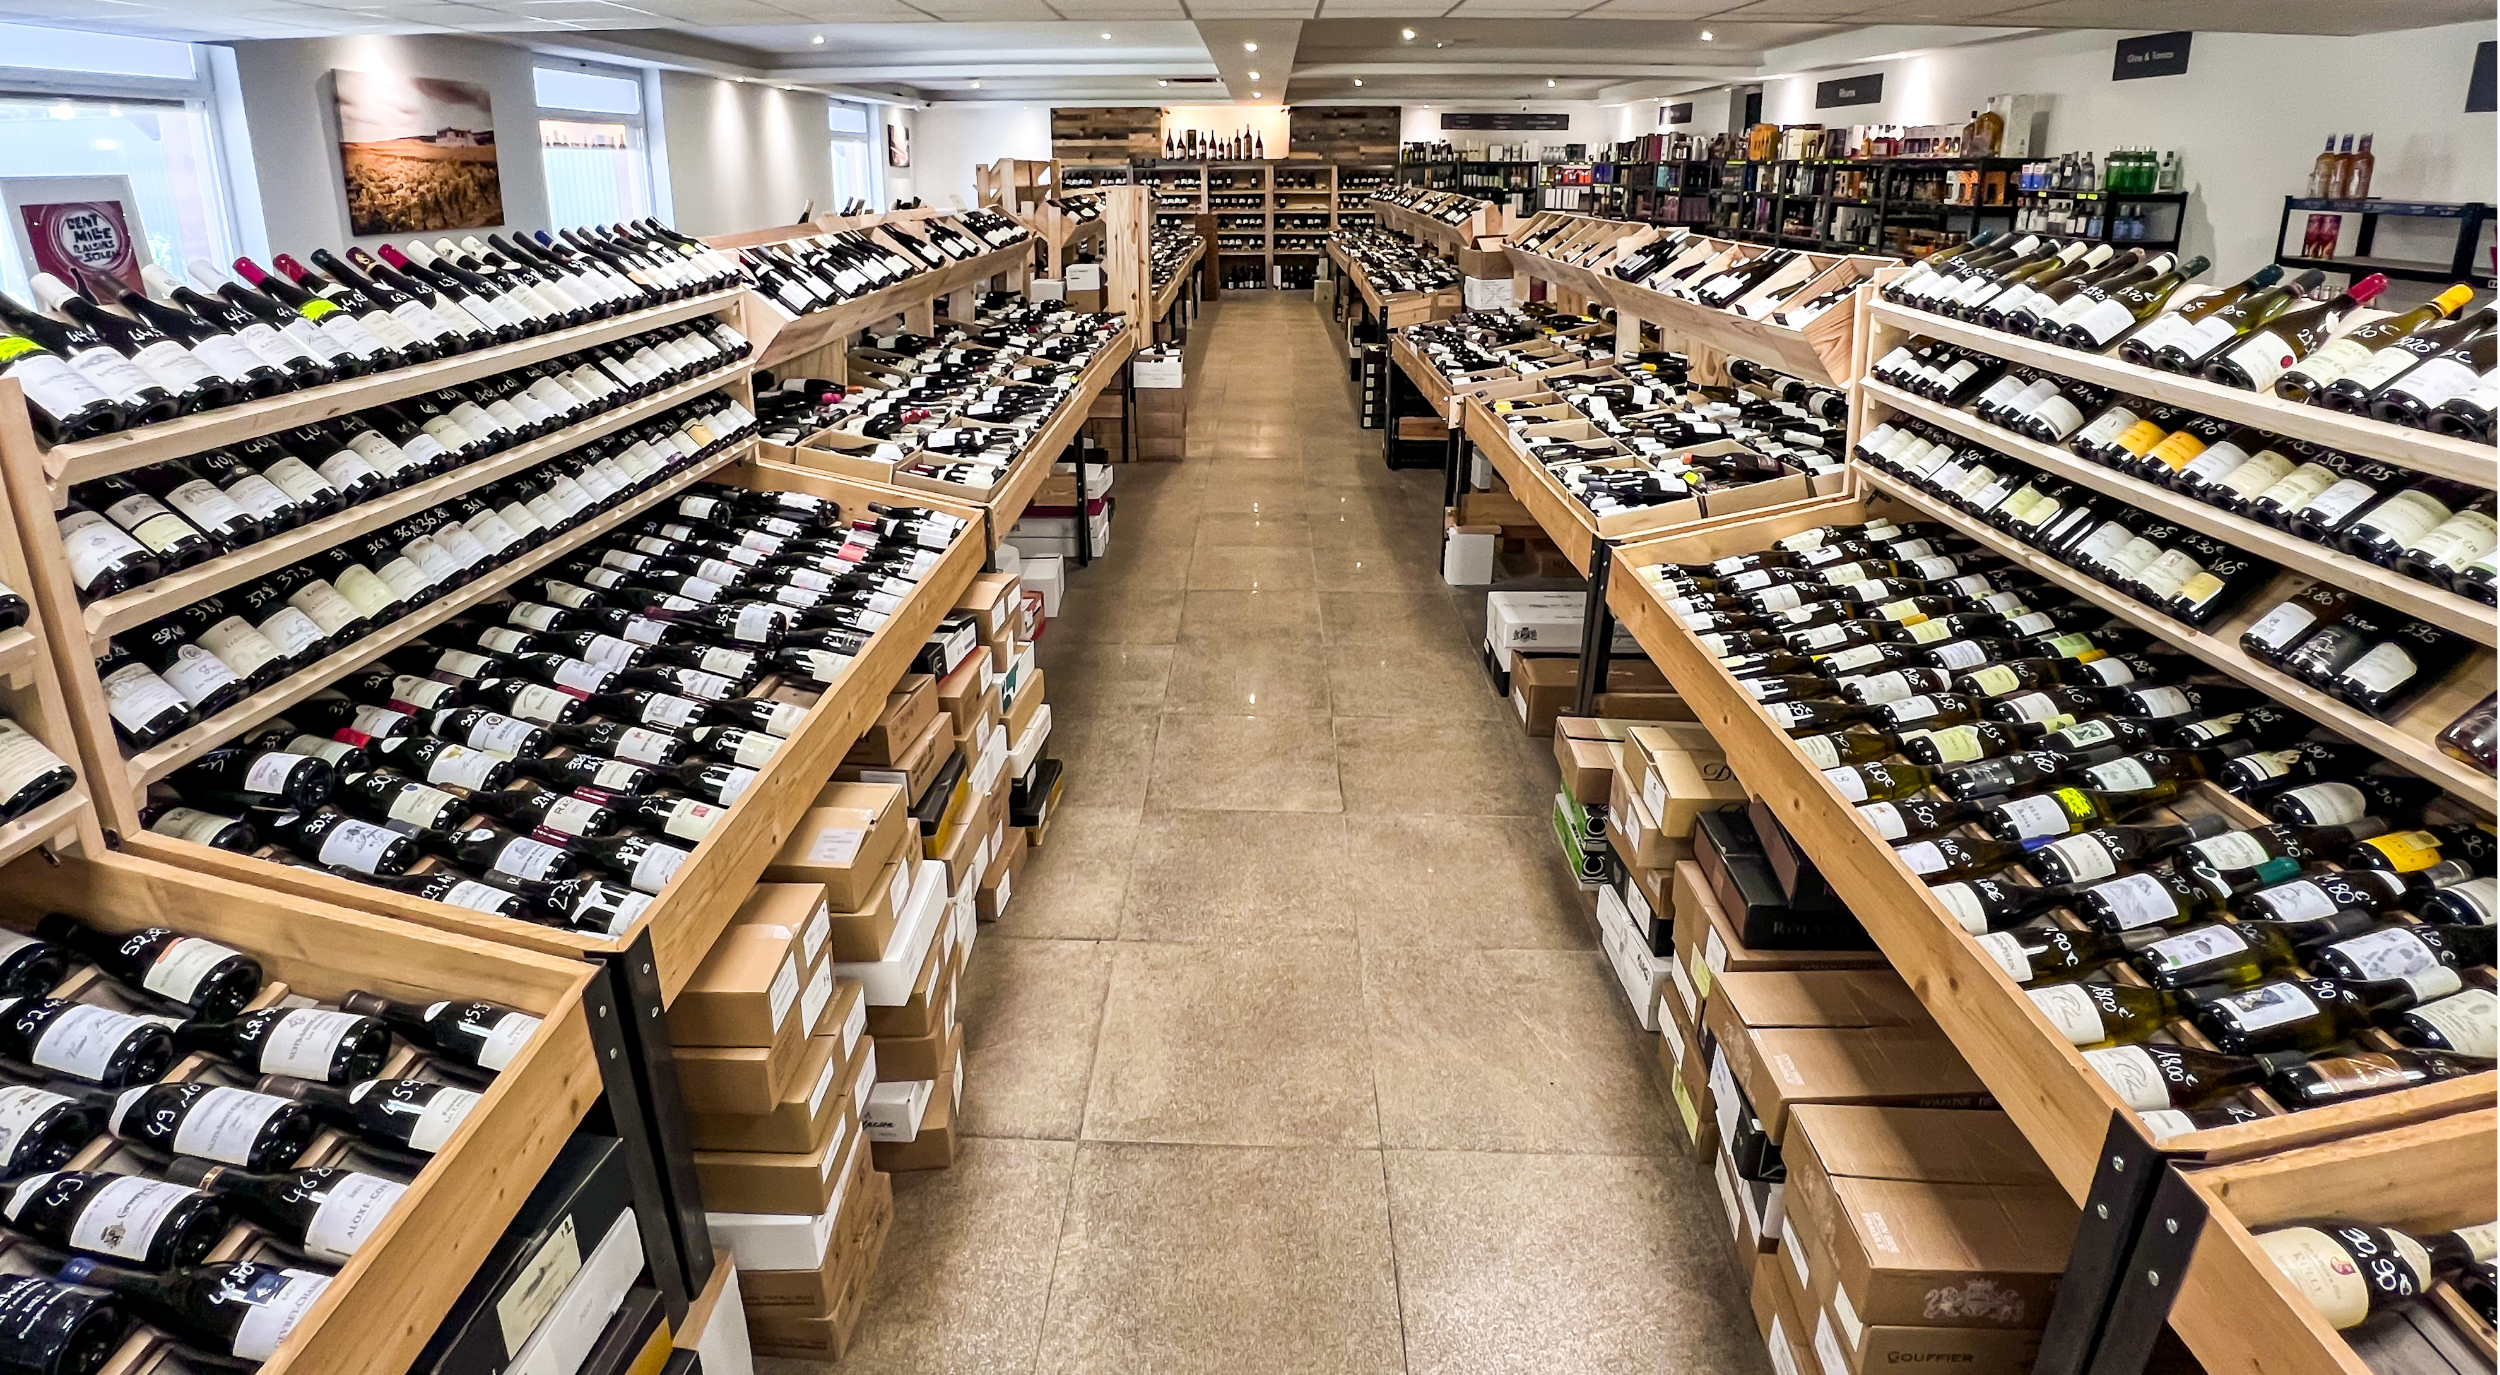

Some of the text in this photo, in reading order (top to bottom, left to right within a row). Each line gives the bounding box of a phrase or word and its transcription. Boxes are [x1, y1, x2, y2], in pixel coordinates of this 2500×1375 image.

[66, 214, 98, 229] CENT
[74, 227, 112, 242] MILLE
[1887, 1351, 1974, 1364] GOUFFIER
